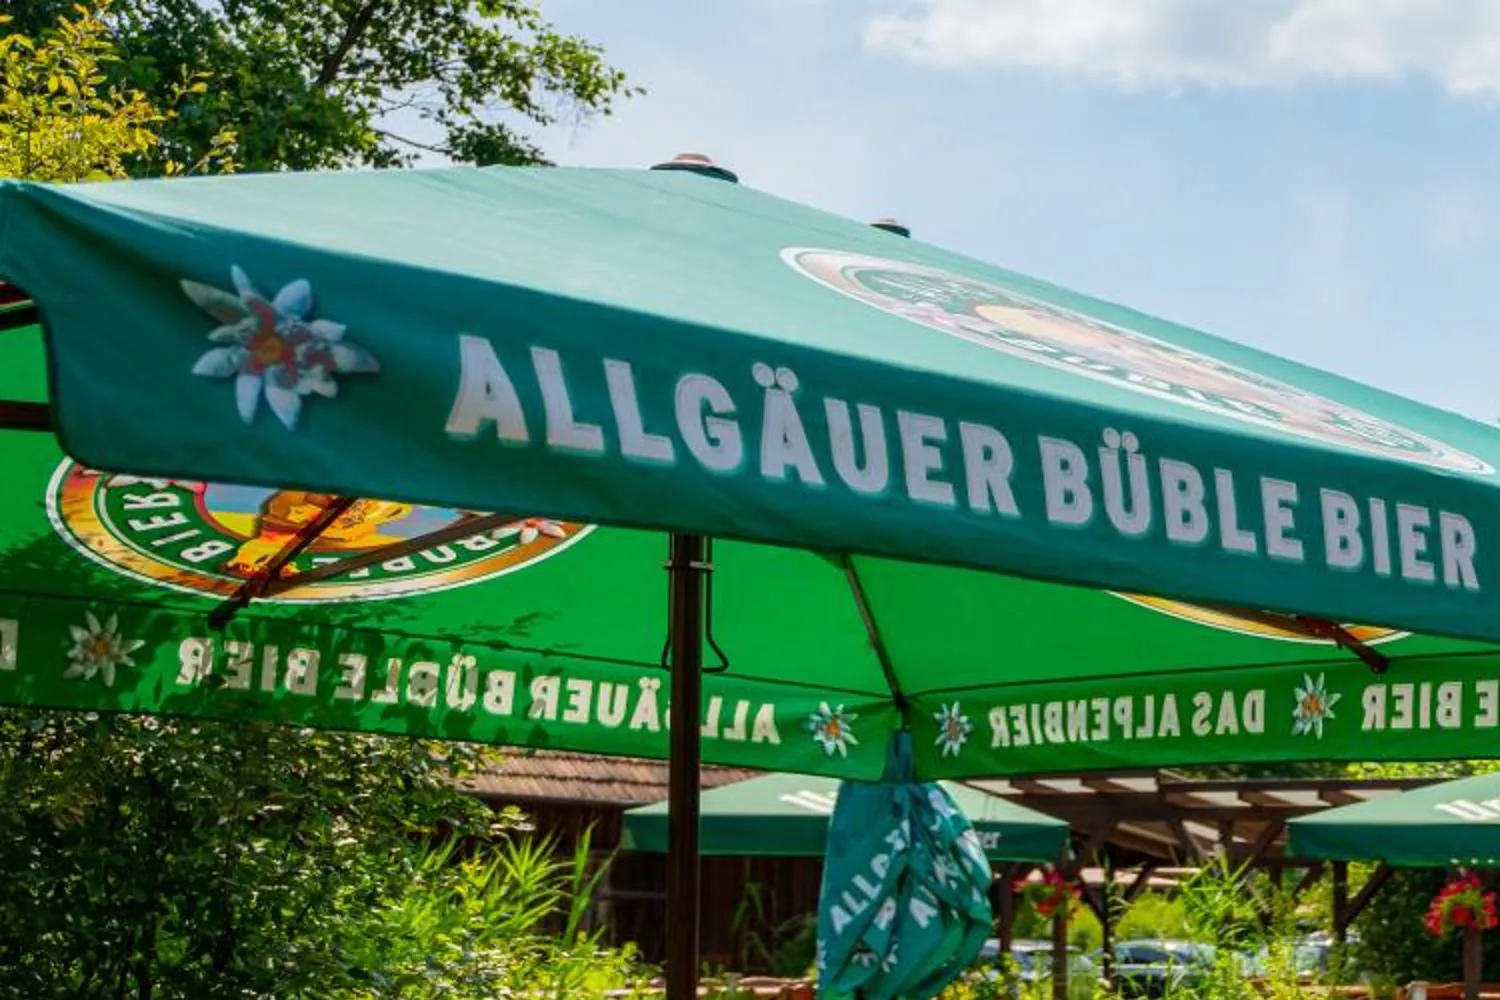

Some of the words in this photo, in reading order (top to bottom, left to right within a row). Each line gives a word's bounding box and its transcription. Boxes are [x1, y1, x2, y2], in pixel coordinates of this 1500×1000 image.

[445, 335, 1020, 516] ALLGÄUER
[1038, 427, 1304, 560] BÜBLE
[1319, 487, 1480, 590] BIER
